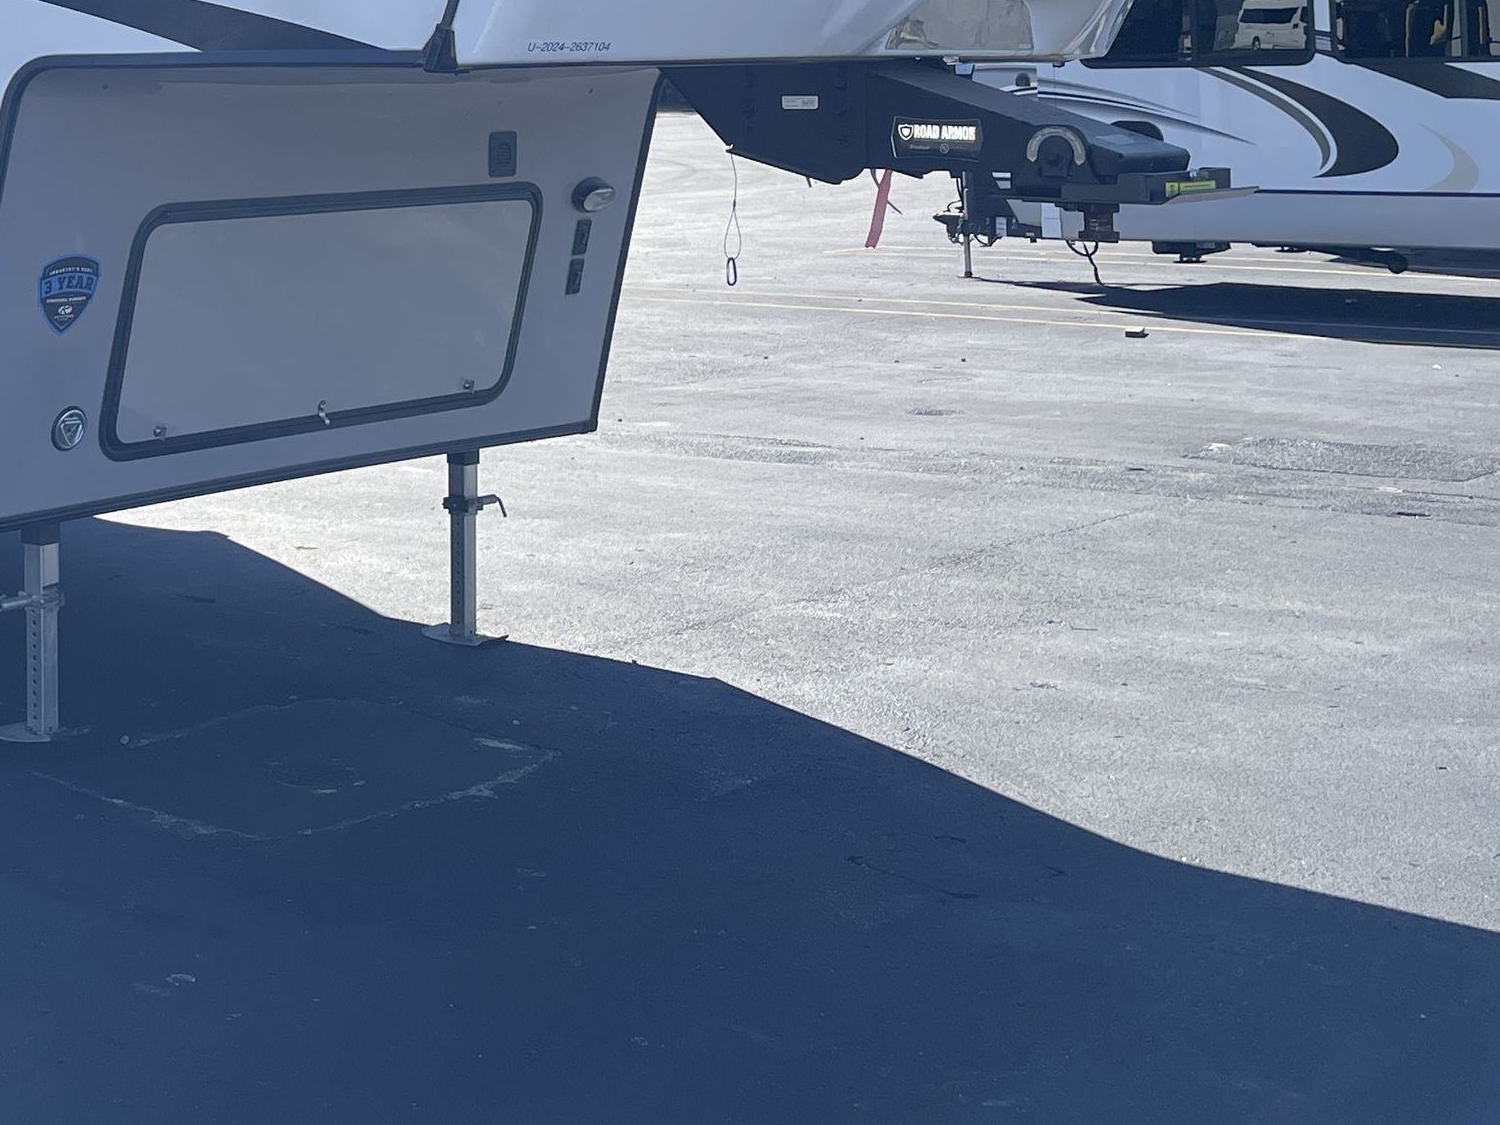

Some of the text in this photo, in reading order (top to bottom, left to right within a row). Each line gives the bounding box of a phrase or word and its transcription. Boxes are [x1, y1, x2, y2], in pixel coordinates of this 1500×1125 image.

[527, 41, 612, 52] U-2024-2637104
[913, 124, 977, 141] ROAD ARMOR
[44, 275, 94, 295] 3 YEAR
